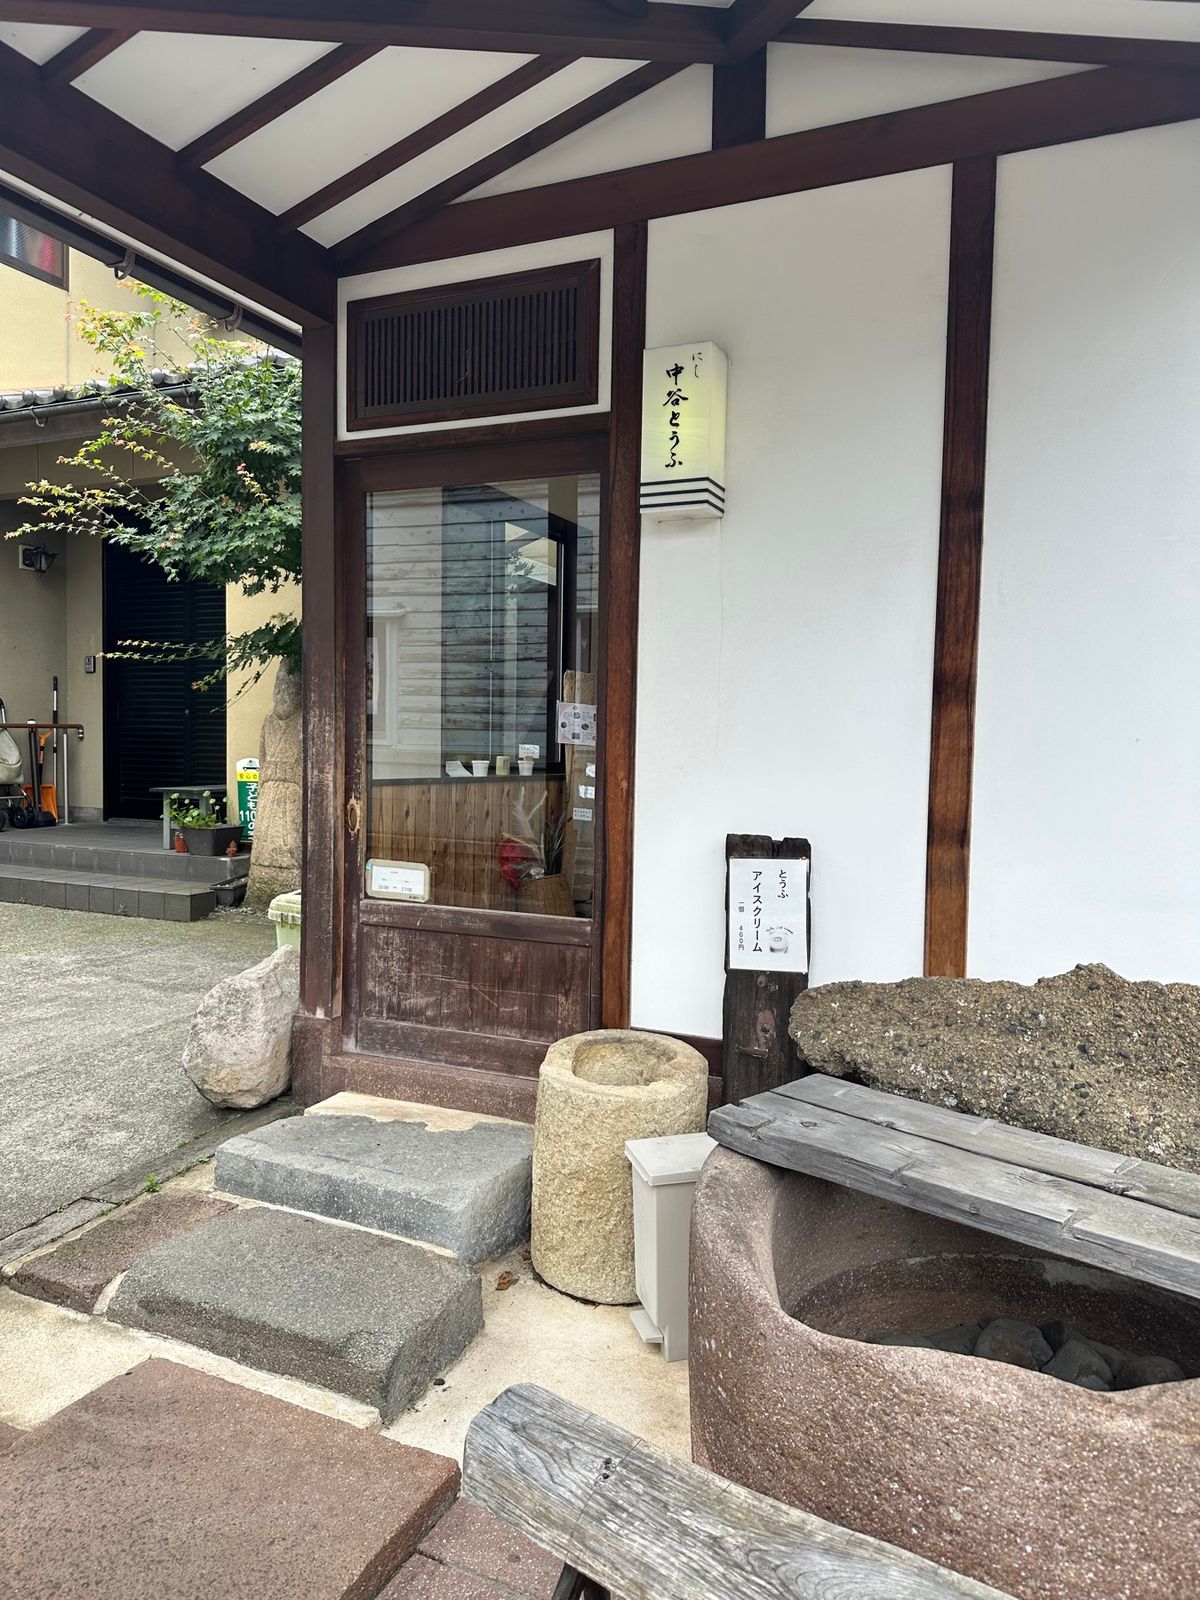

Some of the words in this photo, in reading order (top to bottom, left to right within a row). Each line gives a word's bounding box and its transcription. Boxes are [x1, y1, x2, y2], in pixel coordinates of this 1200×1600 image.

[692, 352, 703, 378] にし
[662, 363, 689, 468] 中谷とうふ
[752, 870, 763, 953] アイスクリーム
[777, 869, 789, 899] とうふ
